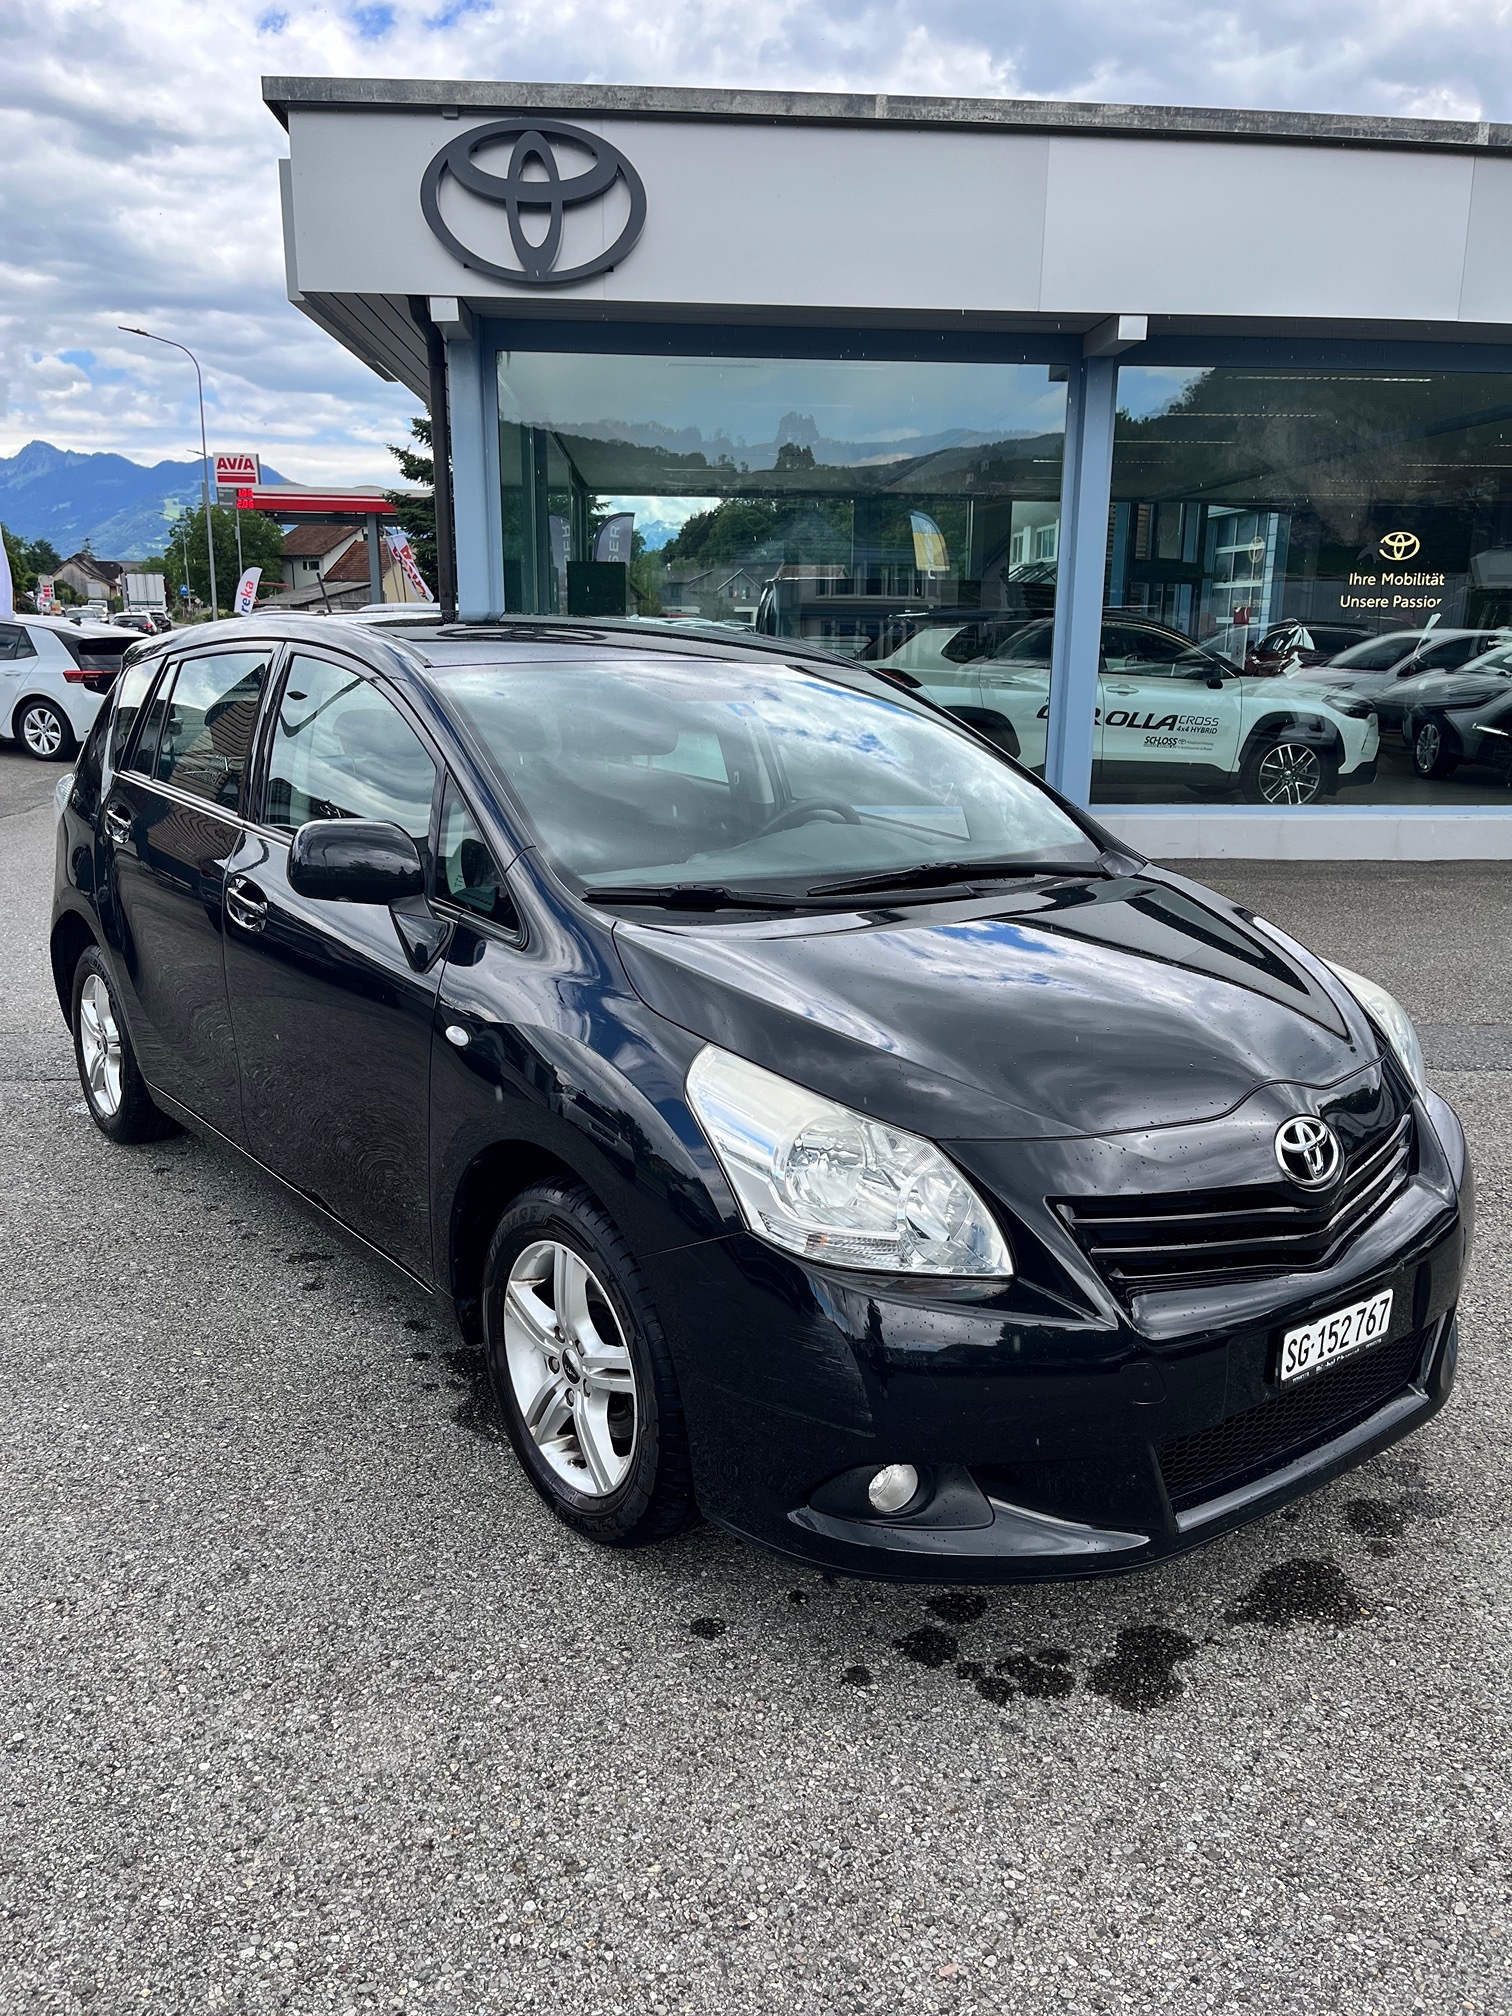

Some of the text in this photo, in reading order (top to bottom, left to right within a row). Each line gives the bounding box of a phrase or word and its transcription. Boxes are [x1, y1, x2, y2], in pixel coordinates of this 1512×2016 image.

[1349, 572, 1445, 586] Ihre Mobilität
[240, 580, 255, 613] reka
[1340, 595, 1389, 608] Unsere
[1178, 715, 1220, 727] CROSS
[1176, 725, 1218, 735] 4x4 HYBRID
[1144, 736, 1178, 746] SCHLOSS
